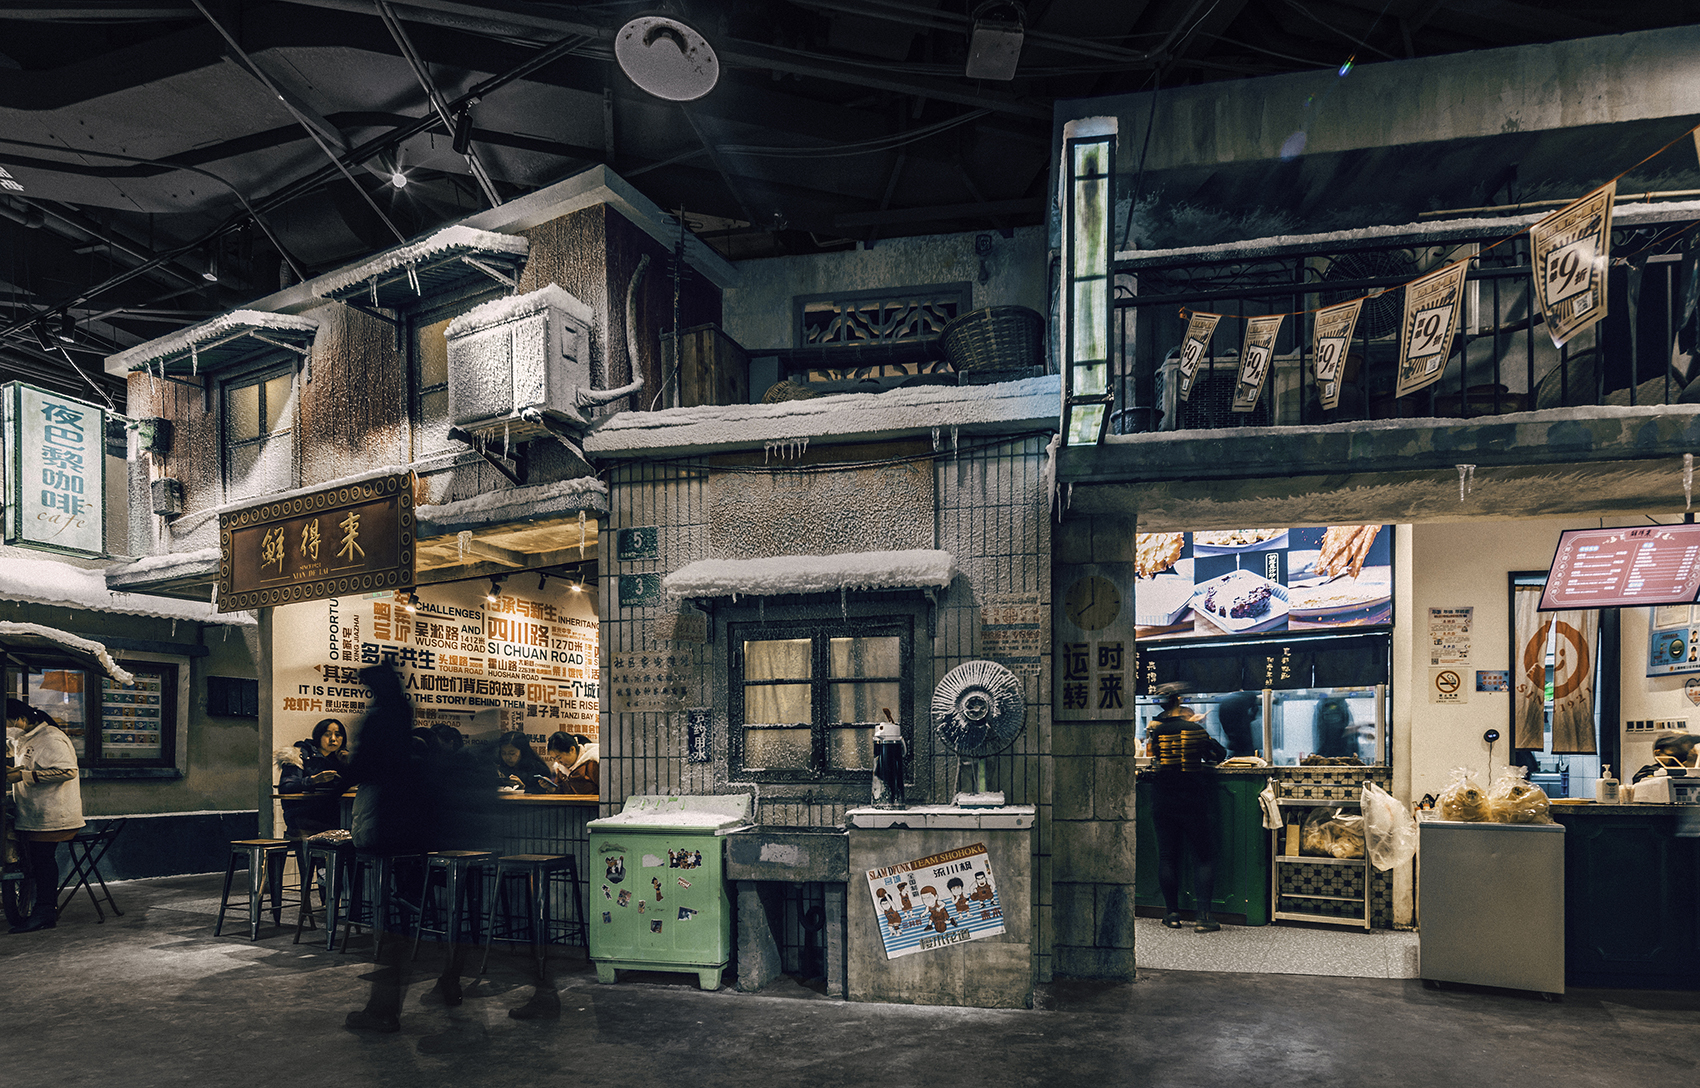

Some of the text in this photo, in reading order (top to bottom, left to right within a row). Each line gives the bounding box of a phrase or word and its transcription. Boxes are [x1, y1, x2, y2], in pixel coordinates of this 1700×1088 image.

[1418, 314, 1441, 351] 9
[33, 503, 93, 541] cafe
[633, 531, 642, 548] 5
[635, 577, 643, 595] 3
[416, 601, 481, 620] CHALLENGES
[329, 598, 339, 660] OPPORTU
[373, 602, 391, 641] 机遇
[415, 621, 459, 641] 吴淞路
[461, 624, 481, 636] AND
[488, 616, 549, 647] 四川路
[558, 615, 599, 630] INHERITANC
[415, 637, 486, 653] WUSONG ROAD
[488, 642, 583, 665] SI CHUAN ROAD
[551, 639, 583, 652] 1270米
[438, 665, 484, 675] TOUBA ROAD
[488, 658, 517, 672] 霍山路
[402, 673, 525, 697] 人和他们背后的故事
[488, 670, 539, 681] HUOSHAN ROAD
[1063, 643, 1089, 709] 运转
[1098, 643, 1124, 709] 时来
[299, 685, 310, 694] IT
[313, 686, 324, 695] IS
[327, 687, 375, 699] EVERYO
[414, 693, 434, 703] THE
[436, 695, 467, 705] STORY
[469, 697, 501, 708] BEHIND
[503, 700, 525, 709] THEM
[527, 683, 556, 704] 印记
[559, 699, 599, 711] THE RISE
[560, 711, 594, 720] TANZI BAY
[868, 867, 888, 881] SLAM
[913, 856, 939, 868] TEAM
